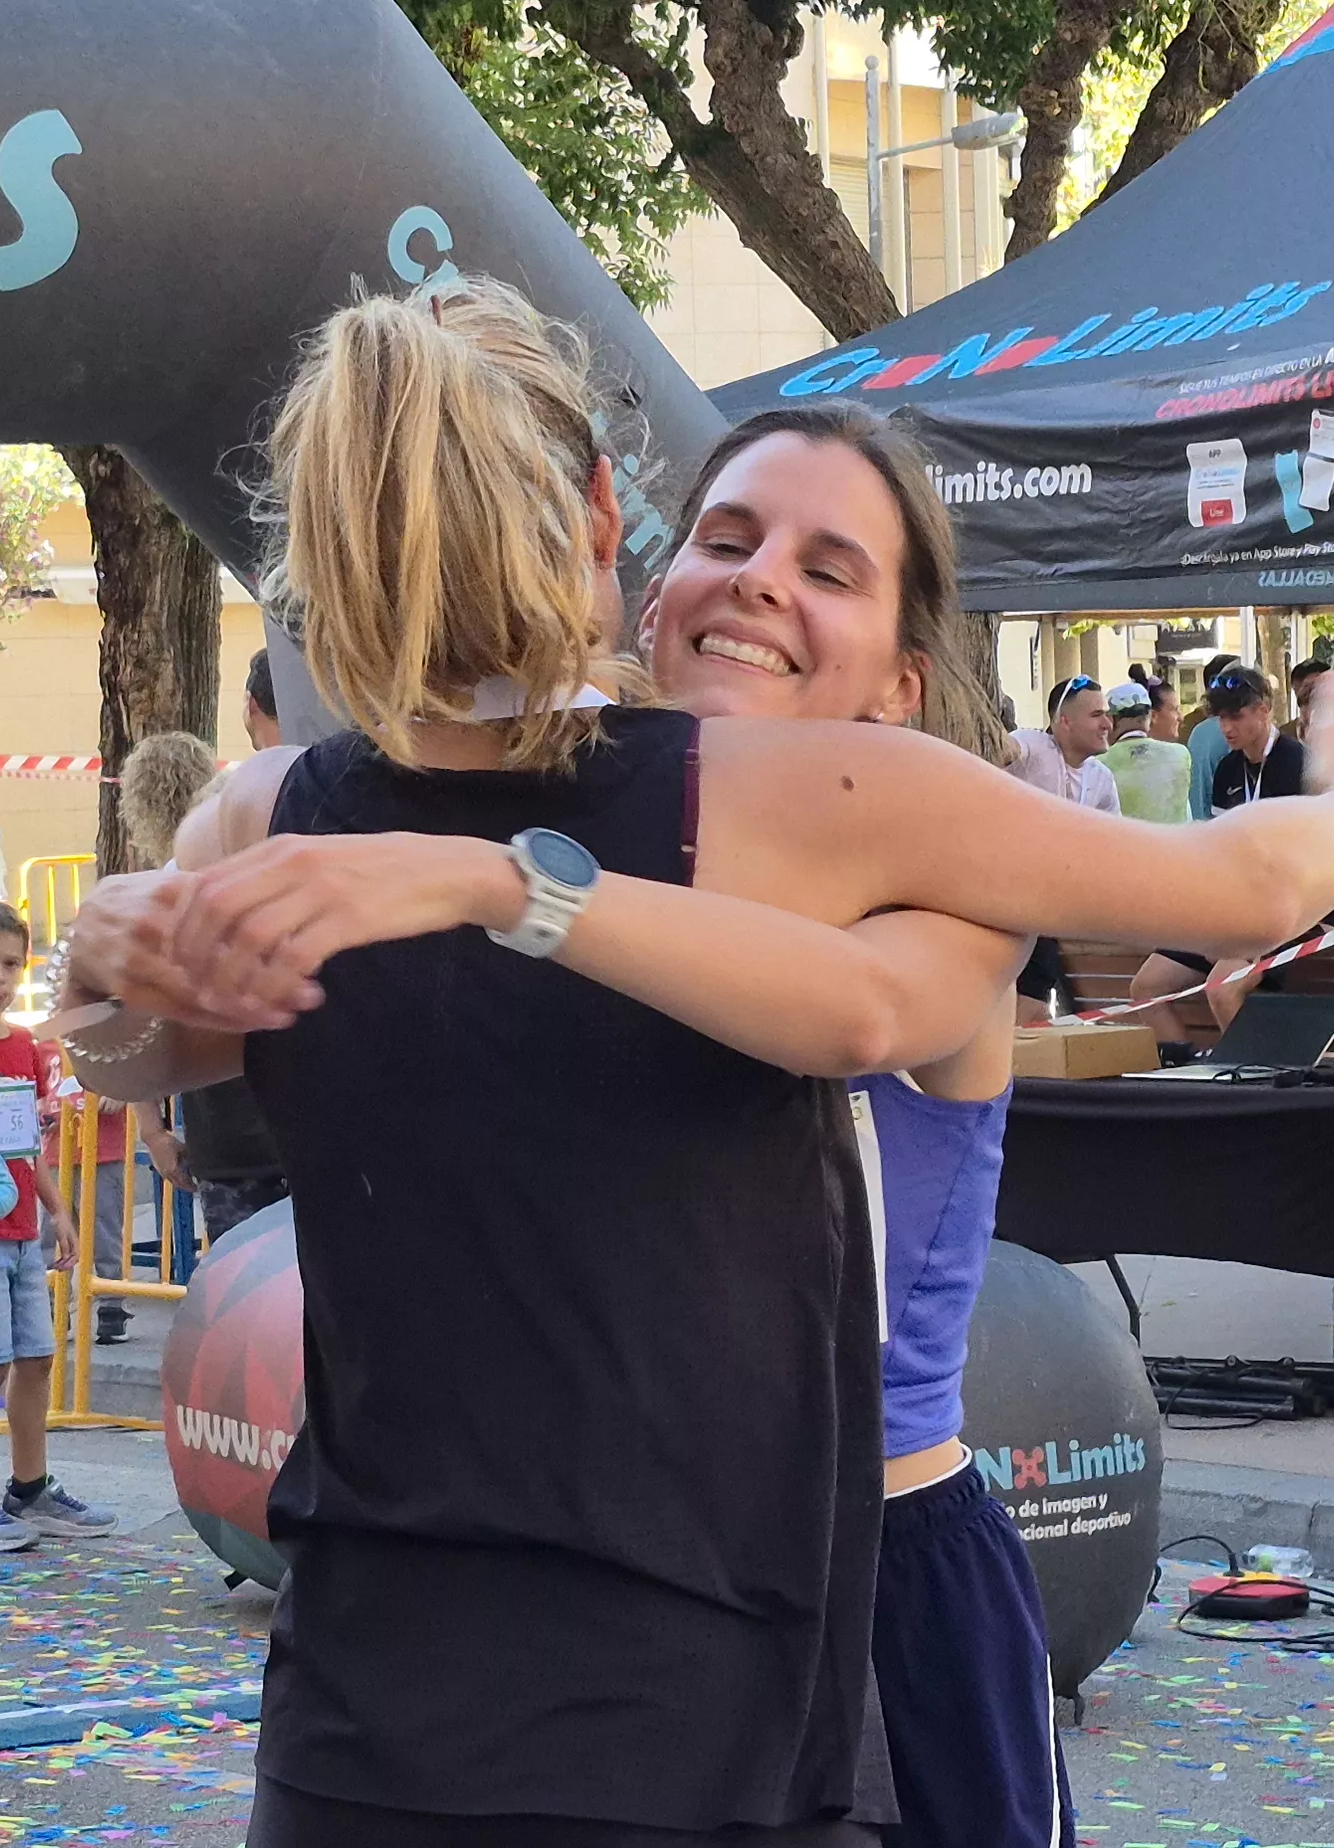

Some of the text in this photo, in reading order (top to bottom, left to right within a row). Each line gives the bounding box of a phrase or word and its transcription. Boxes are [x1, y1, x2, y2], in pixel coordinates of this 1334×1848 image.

[1155, 375, 1306, 419] CRONOLIMITS
[1019, 1499, 1039, 1517] de
[1098, 1493, 1108, 1511] y
[1070, 1511, 1132, 1536] deportivo
